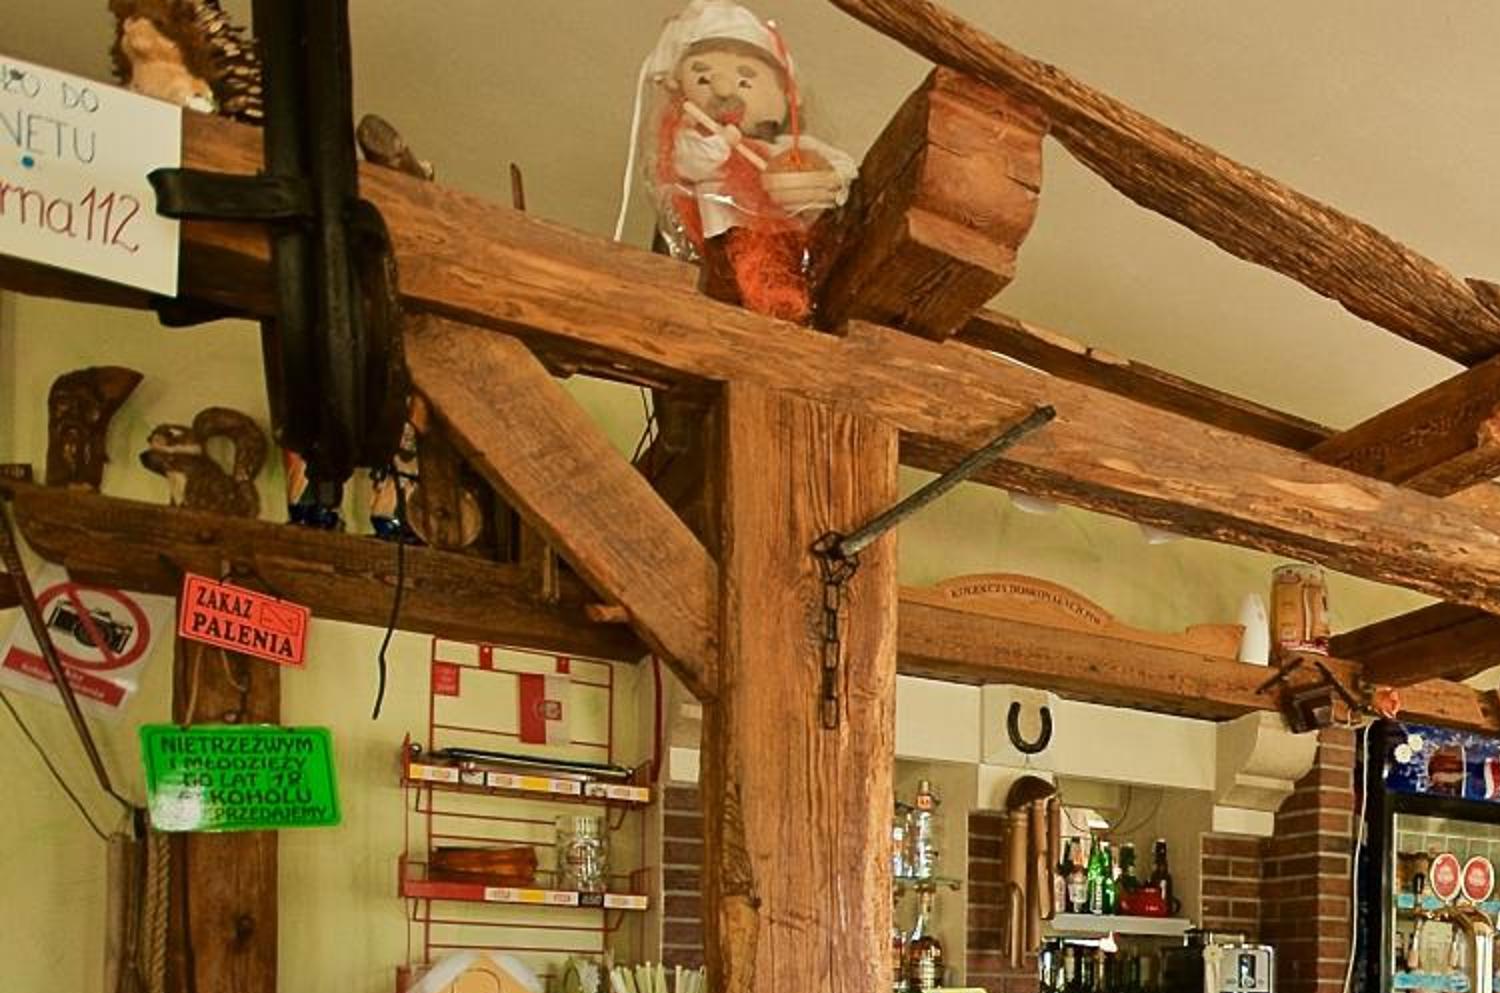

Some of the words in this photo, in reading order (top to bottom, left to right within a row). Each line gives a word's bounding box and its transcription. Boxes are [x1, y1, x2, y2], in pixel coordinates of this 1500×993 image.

[62, 81, 99, 113] DO
[196, 585, 253, 619] ZAKAZ
[191, 611, 294, 658] PALENIA
[219, 771, 260, 788] LAT
